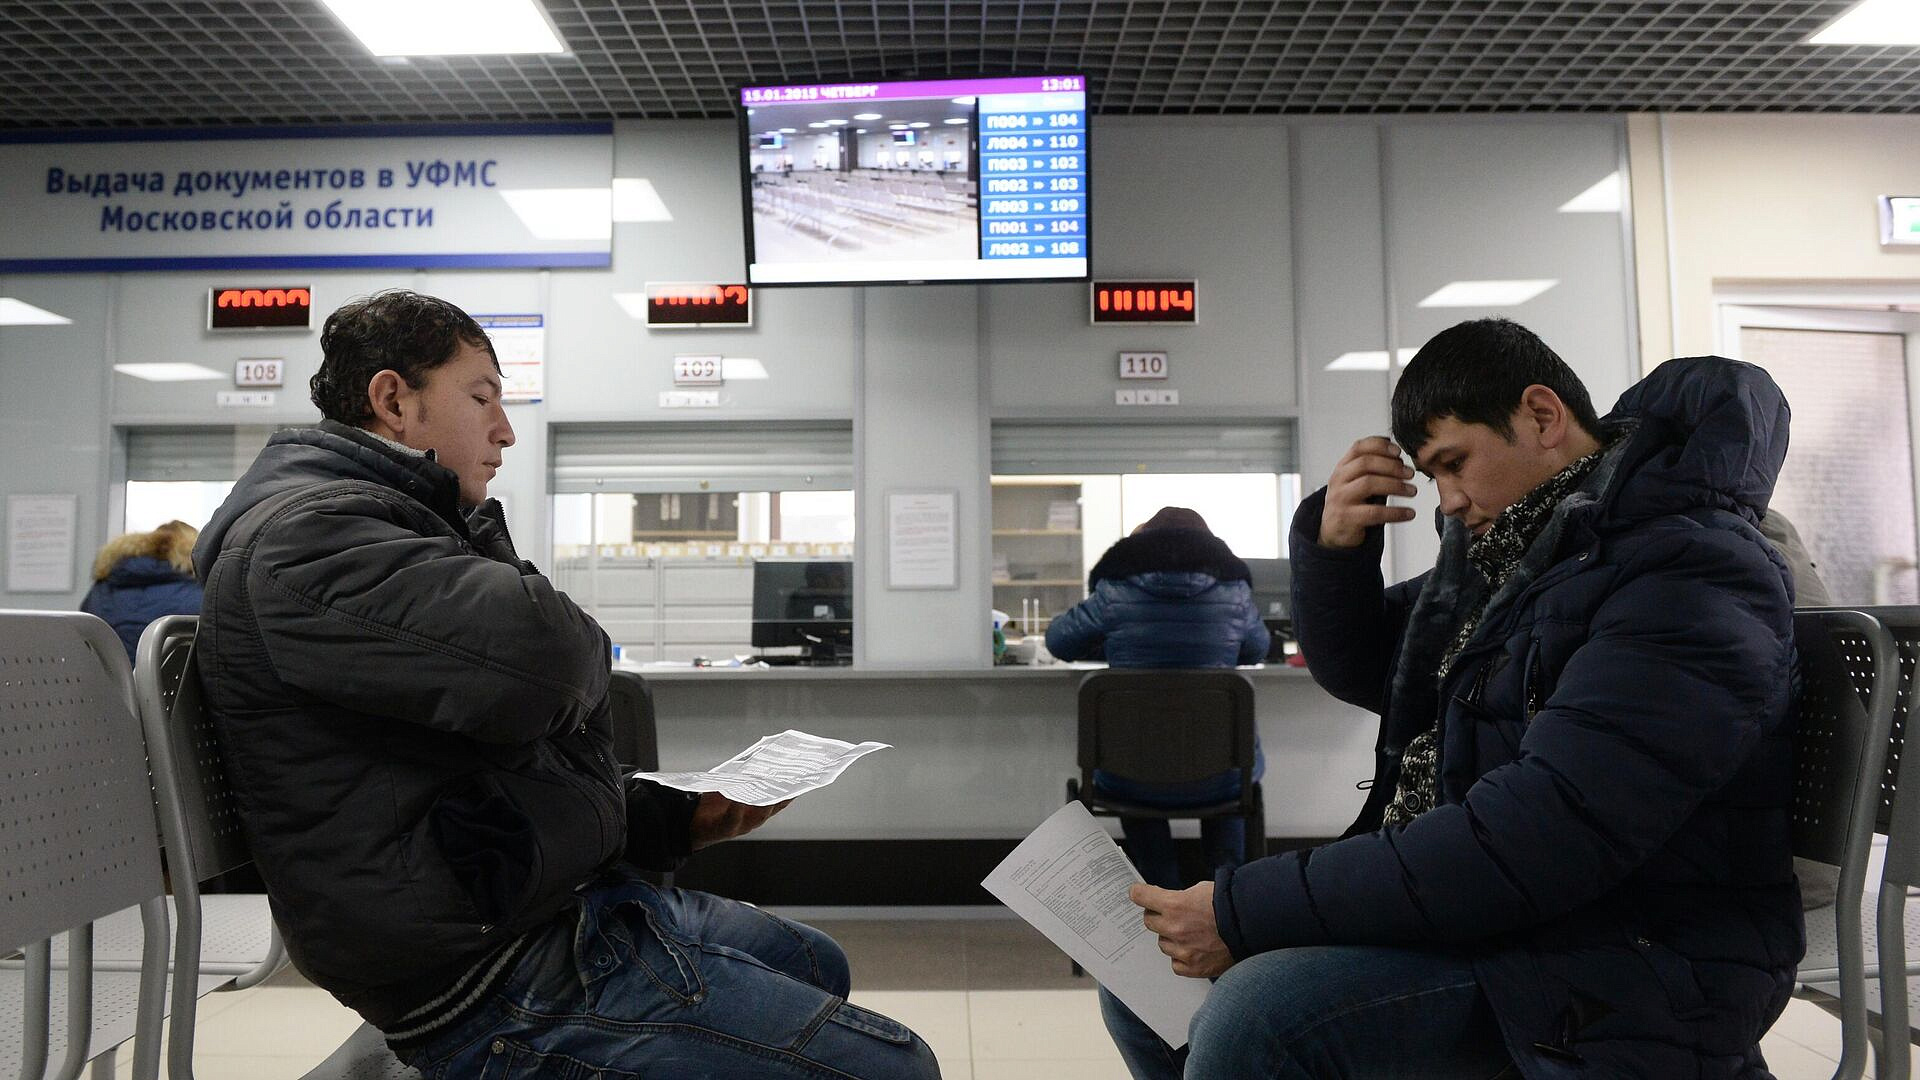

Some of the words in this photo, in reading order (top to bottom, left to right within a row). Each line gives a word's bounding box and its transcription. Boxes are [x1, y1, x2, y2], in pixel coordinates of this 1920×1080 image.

[1041, 78, 1080, 91] 13:01
[744, 87, 818, 102] 15.01.2015
[820, 85, 880, 100] ЧЕТВЕРГ
[986, 115, 1027, 129] П004
[1049, 113, 1078, 127] 104
[986, 136, 1028, 150] Л004
[1049, 135, 1079, 149] 110
[987, 157, 1028, 171] П003
[1049, 156, 1079, 170] 102
[46, 167, 165, 198] Выдача
[173, 168, 365, 198] документов
[378, 168, 394, 188] в
[406, 158, 498, 188] УФМС
[988, 179, 1029, 193] П002
[1050, 177, 1079, 191] 103
[988, 200, 1029, 213] Л003
[1050, 199, 1079, 212] 109
[100, 200, 294, 232] Московской
[305, 199, 434, 229] области
[989, 221, 1029, 234] П001
[1051, 220, 1079, 233] 104
[989, 243, 1030, 256] Л002
[1051, 241, 1080, 255] 108
[242, 364, 278, 382] 108
[681, 360, 715, 378] 109
[1126, 356, 1163, 374] 110
